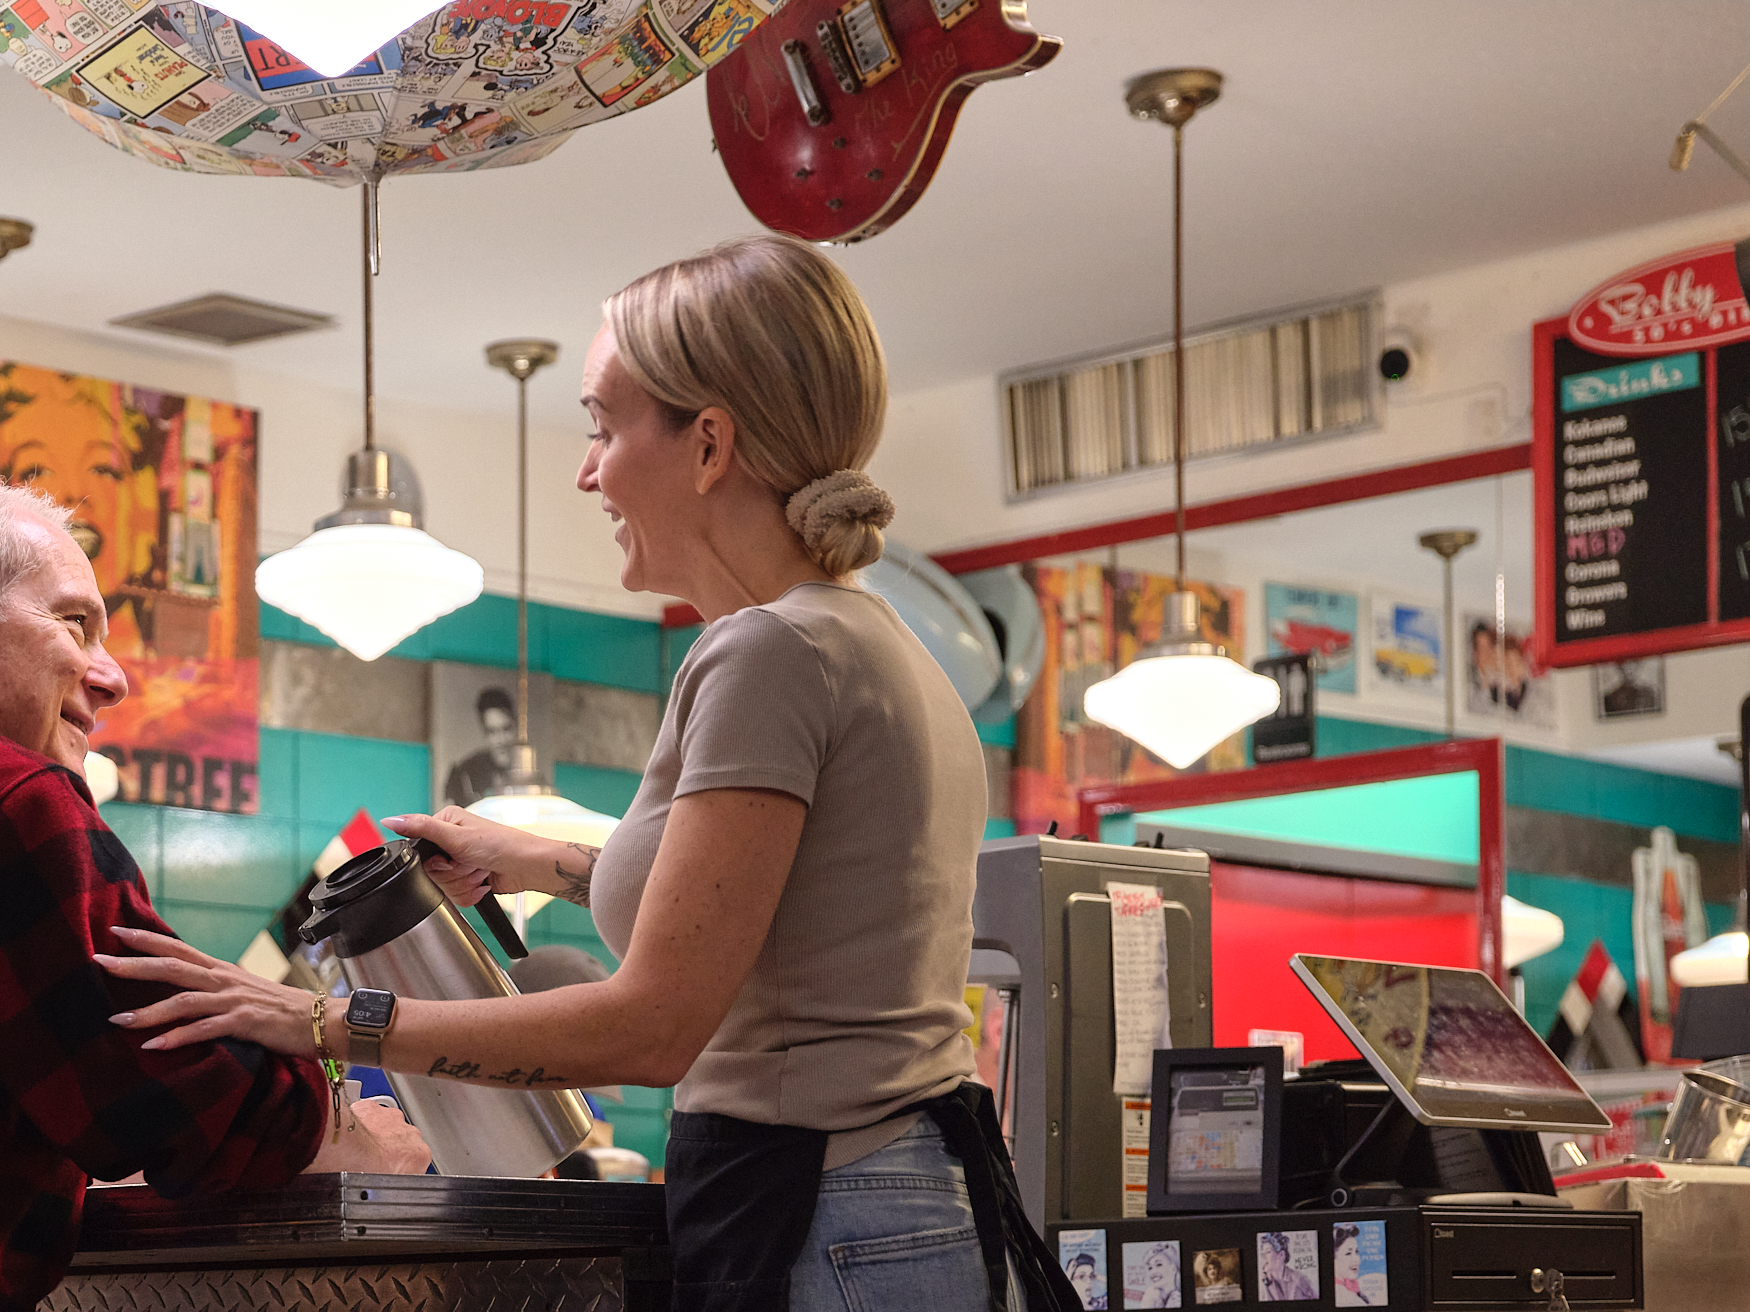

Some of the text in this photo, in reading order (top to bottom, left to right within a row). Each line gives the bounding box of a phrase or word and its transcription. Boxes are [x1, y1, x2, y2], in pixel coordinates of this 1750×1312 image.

[154, 59, 188, 81] PEANUTS
[1597, 266, 1716, 325] Bobby
[1568, 361, 1684, 404] Drinks
[1563, 414, 1628, 442] Kokanee
[1563, 436, 1636, 465] Canadian
[1564, 459, 1641, 489] Budweiser
[1564, 479, 1649, 513] Coors Light
[1565, 508, 1634, 535] Heineken
[1565, 558, 1620, 583] Corona
[353, 1009, 371, 1018] 4:05
[427, 1056, 570, 1087] faith not fear
